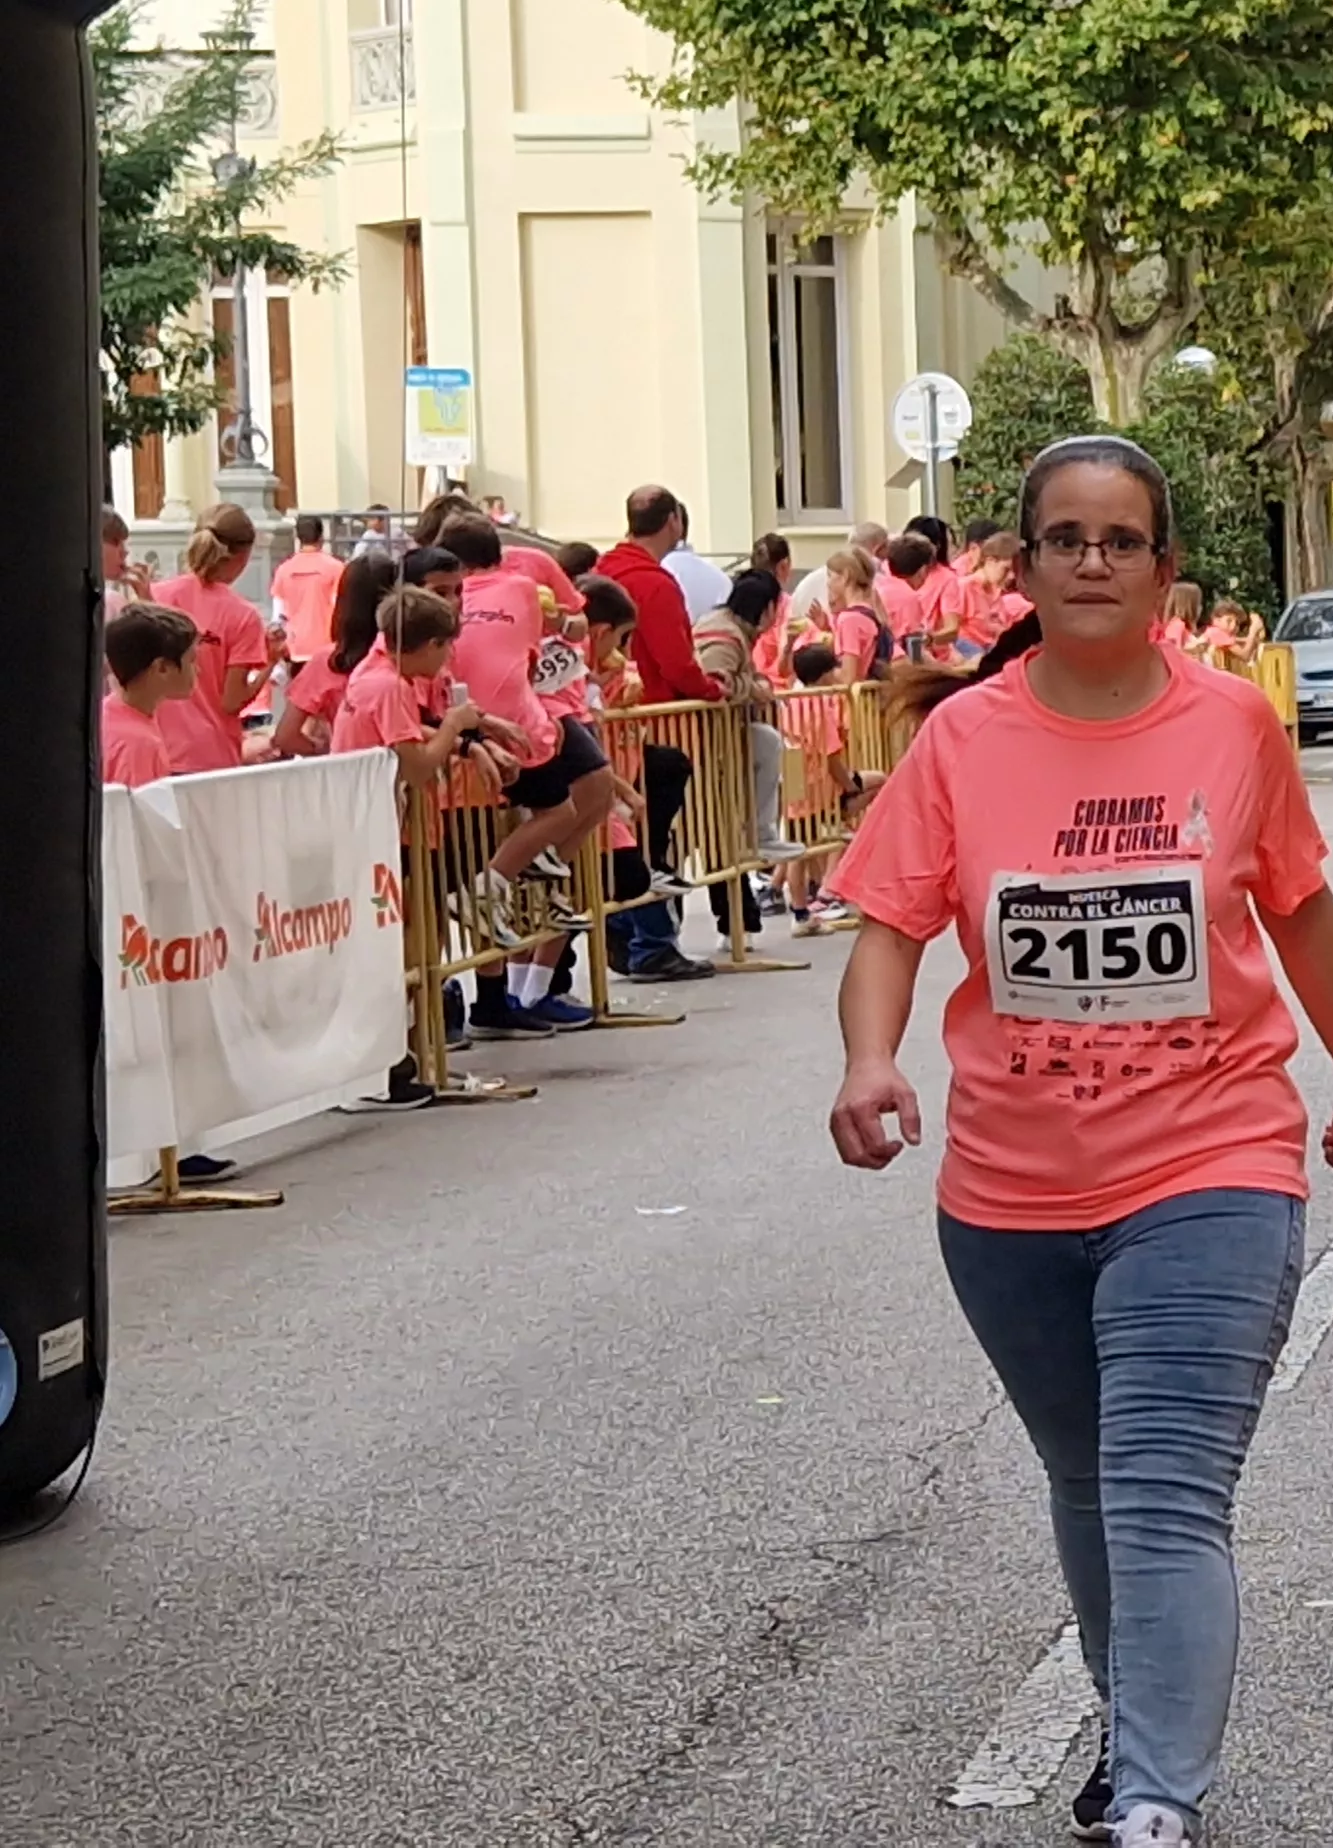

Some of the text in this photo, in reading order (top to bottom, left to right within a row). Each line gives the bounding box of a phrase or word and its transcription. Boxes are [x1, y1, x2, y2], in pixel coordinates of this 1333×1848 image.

[1053, 824, 1178, 857] POR LA CIENCIA
[252, 891, 351, 963] Alcampo
[1008, 897, 1183, 919] CONTRA EL CÁNCER
[1008, 922, 1187, 980] 2150
